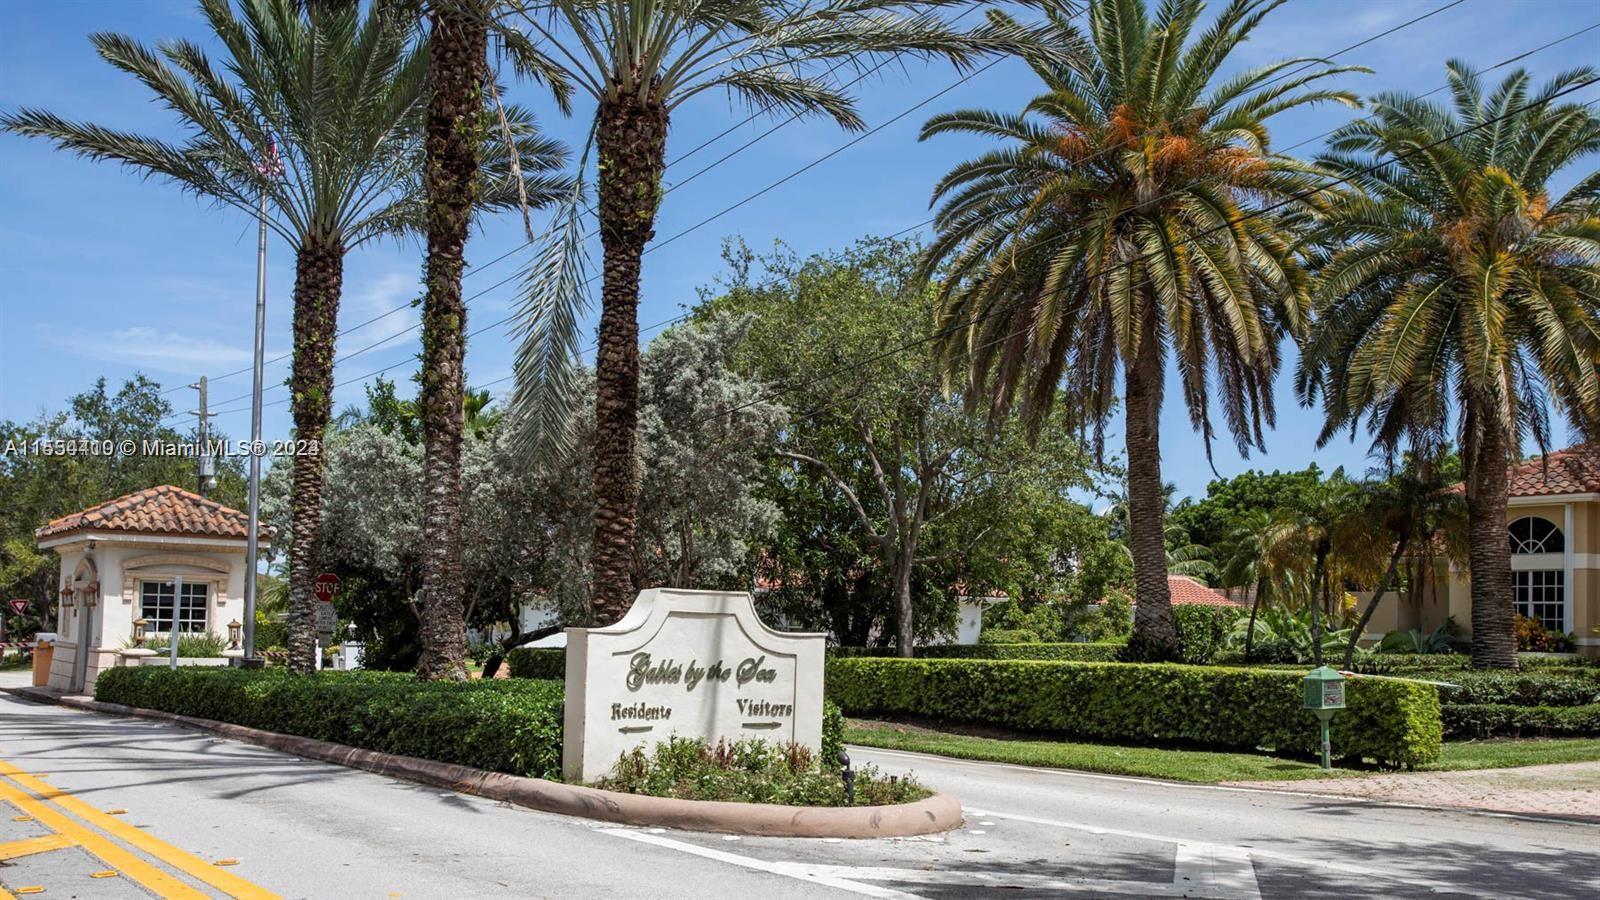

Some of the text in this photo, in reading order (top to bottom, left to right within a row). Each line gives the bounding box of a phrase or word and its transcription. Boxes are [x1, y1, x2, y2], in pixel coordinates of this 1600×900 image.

[626, 652, 777, 692] Gables by the Sea
[611, 702, 672, 721] Residents
[736, 699, 793, 717] Visitors
